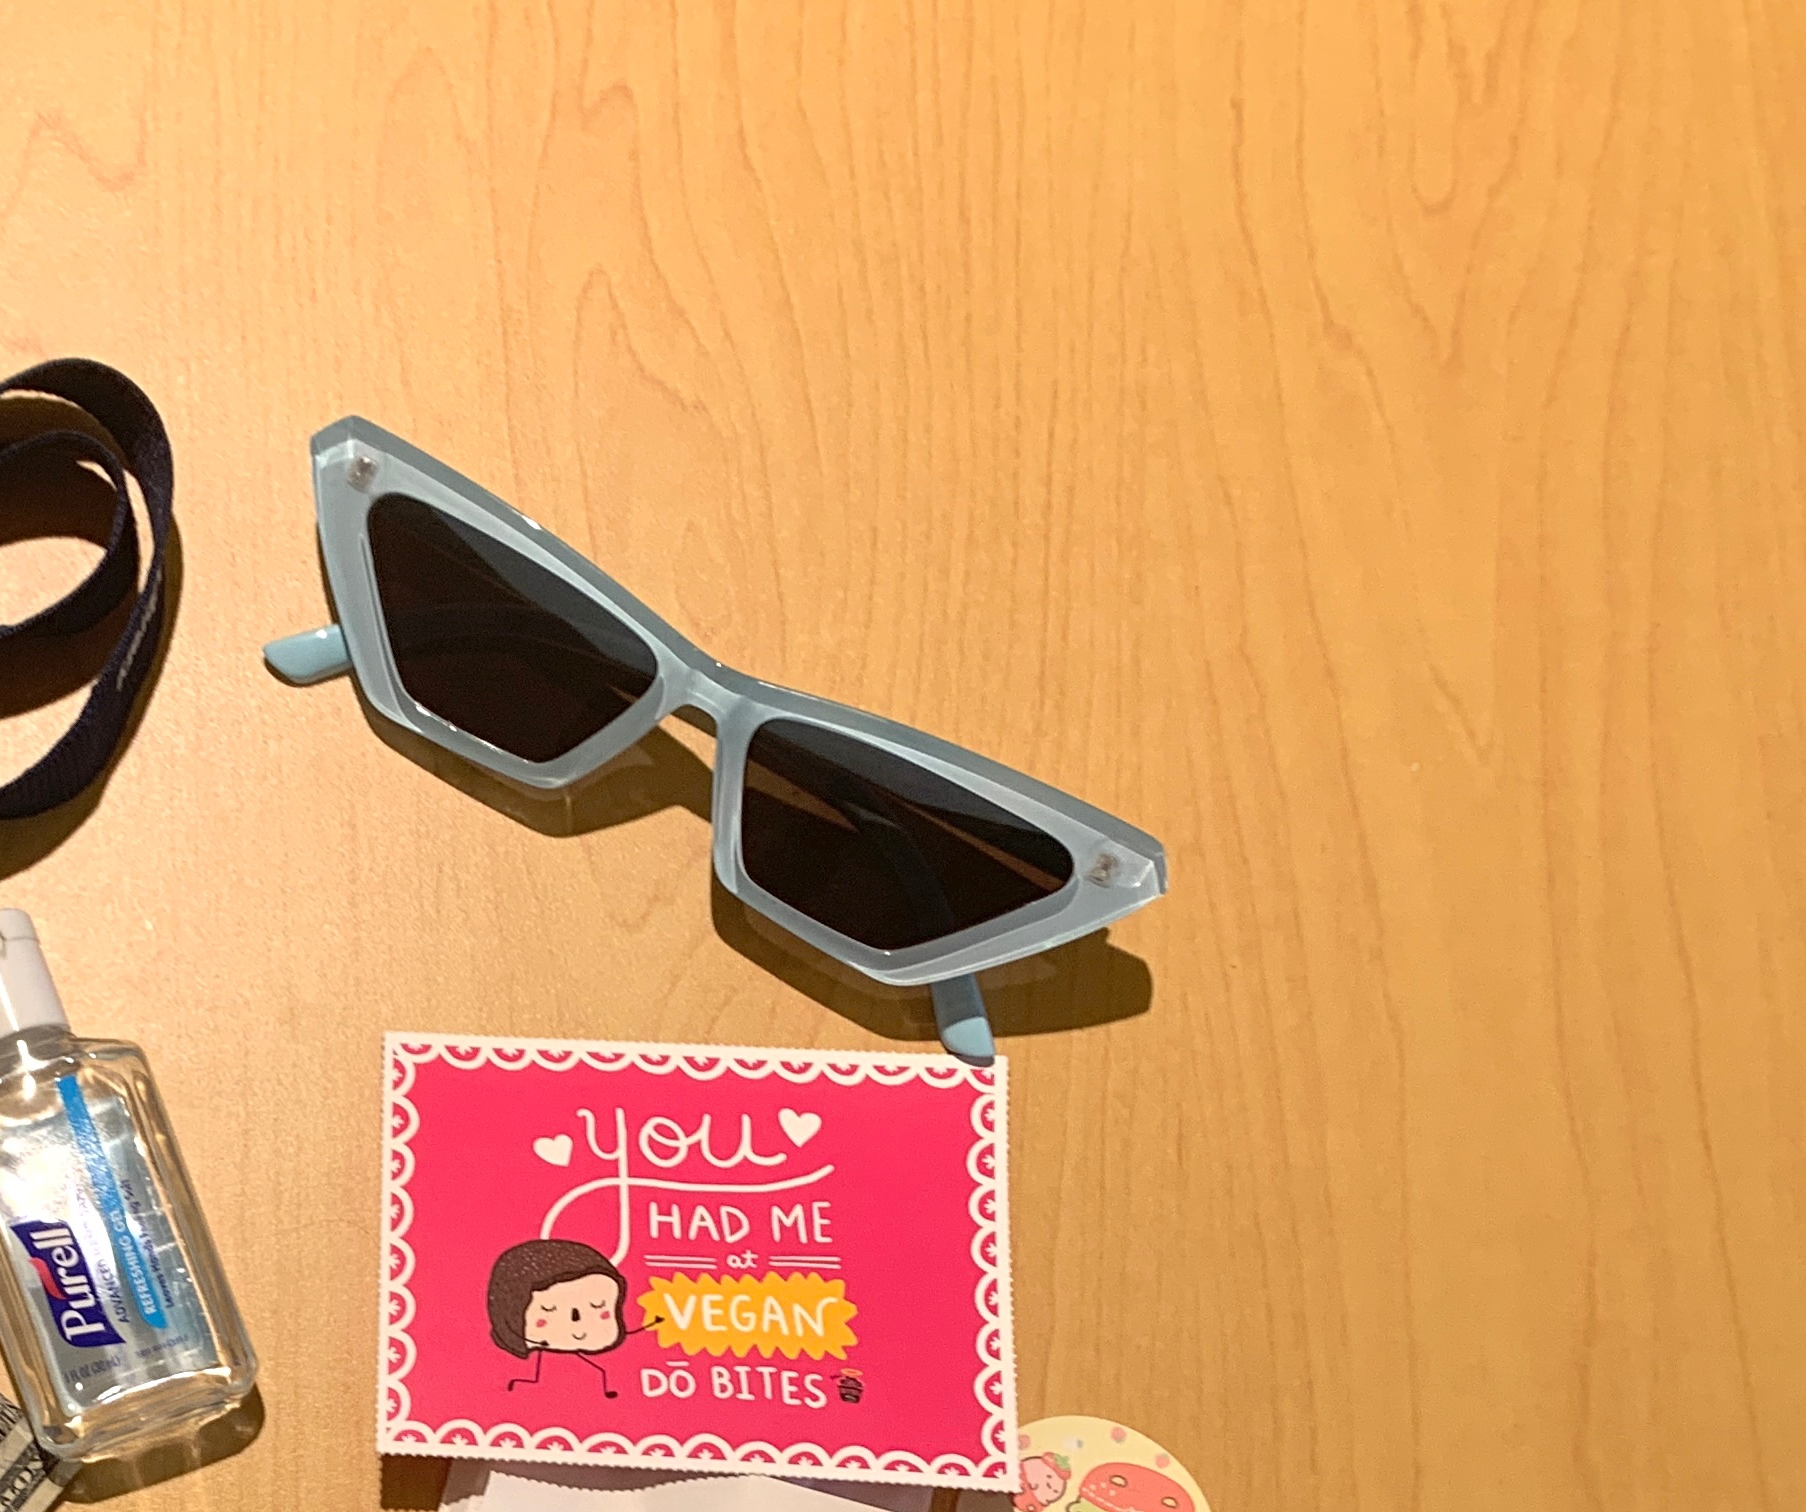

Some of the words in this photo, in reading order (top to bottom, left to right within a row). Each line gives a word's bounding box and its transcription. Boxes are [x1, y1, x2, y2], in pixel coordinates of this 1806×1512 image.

[648, 1201, 750, 1243] HAD
[771, 1201, 833, 1244] ME
[28, 1219, 106, 1343] Purell
[117, 1233, 157, 1316] REFRESHING
[725, 1250, 760, 1270] at
[96, 1257, 131, 1325] ADVANCED
[662, 1293, 840, 1337] VEGAN
[712, 1365, 828, 1410] BITES
